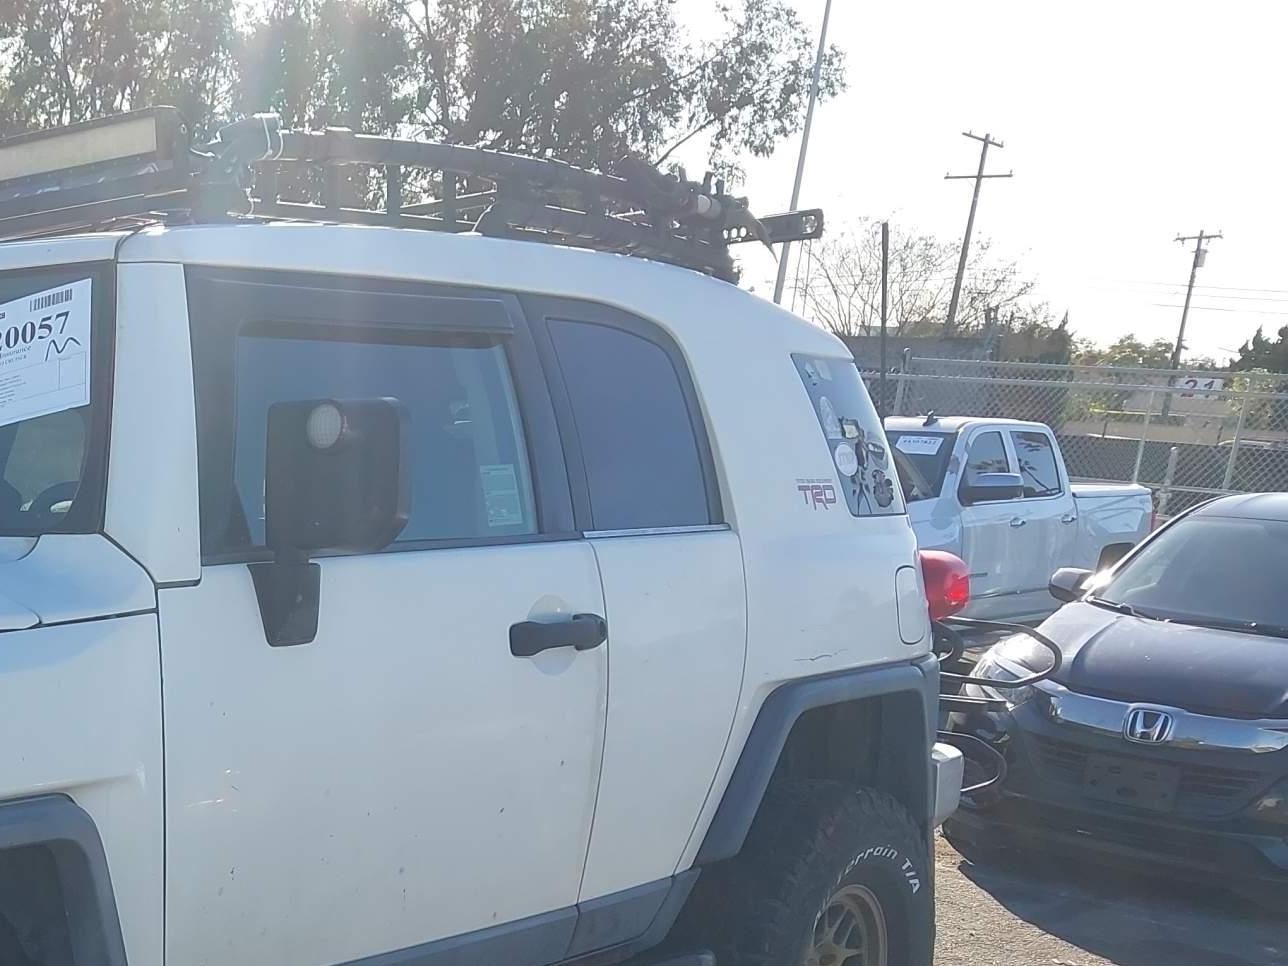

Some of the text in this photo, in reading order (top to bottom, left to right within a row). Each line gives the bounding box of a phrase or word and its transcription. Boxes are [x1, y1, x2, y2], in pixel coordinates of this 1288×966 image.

[0, 345, 32, 359] Insurance
[797, 484, 837, 511] TRD
[901, 857, 921, 894] T/A
